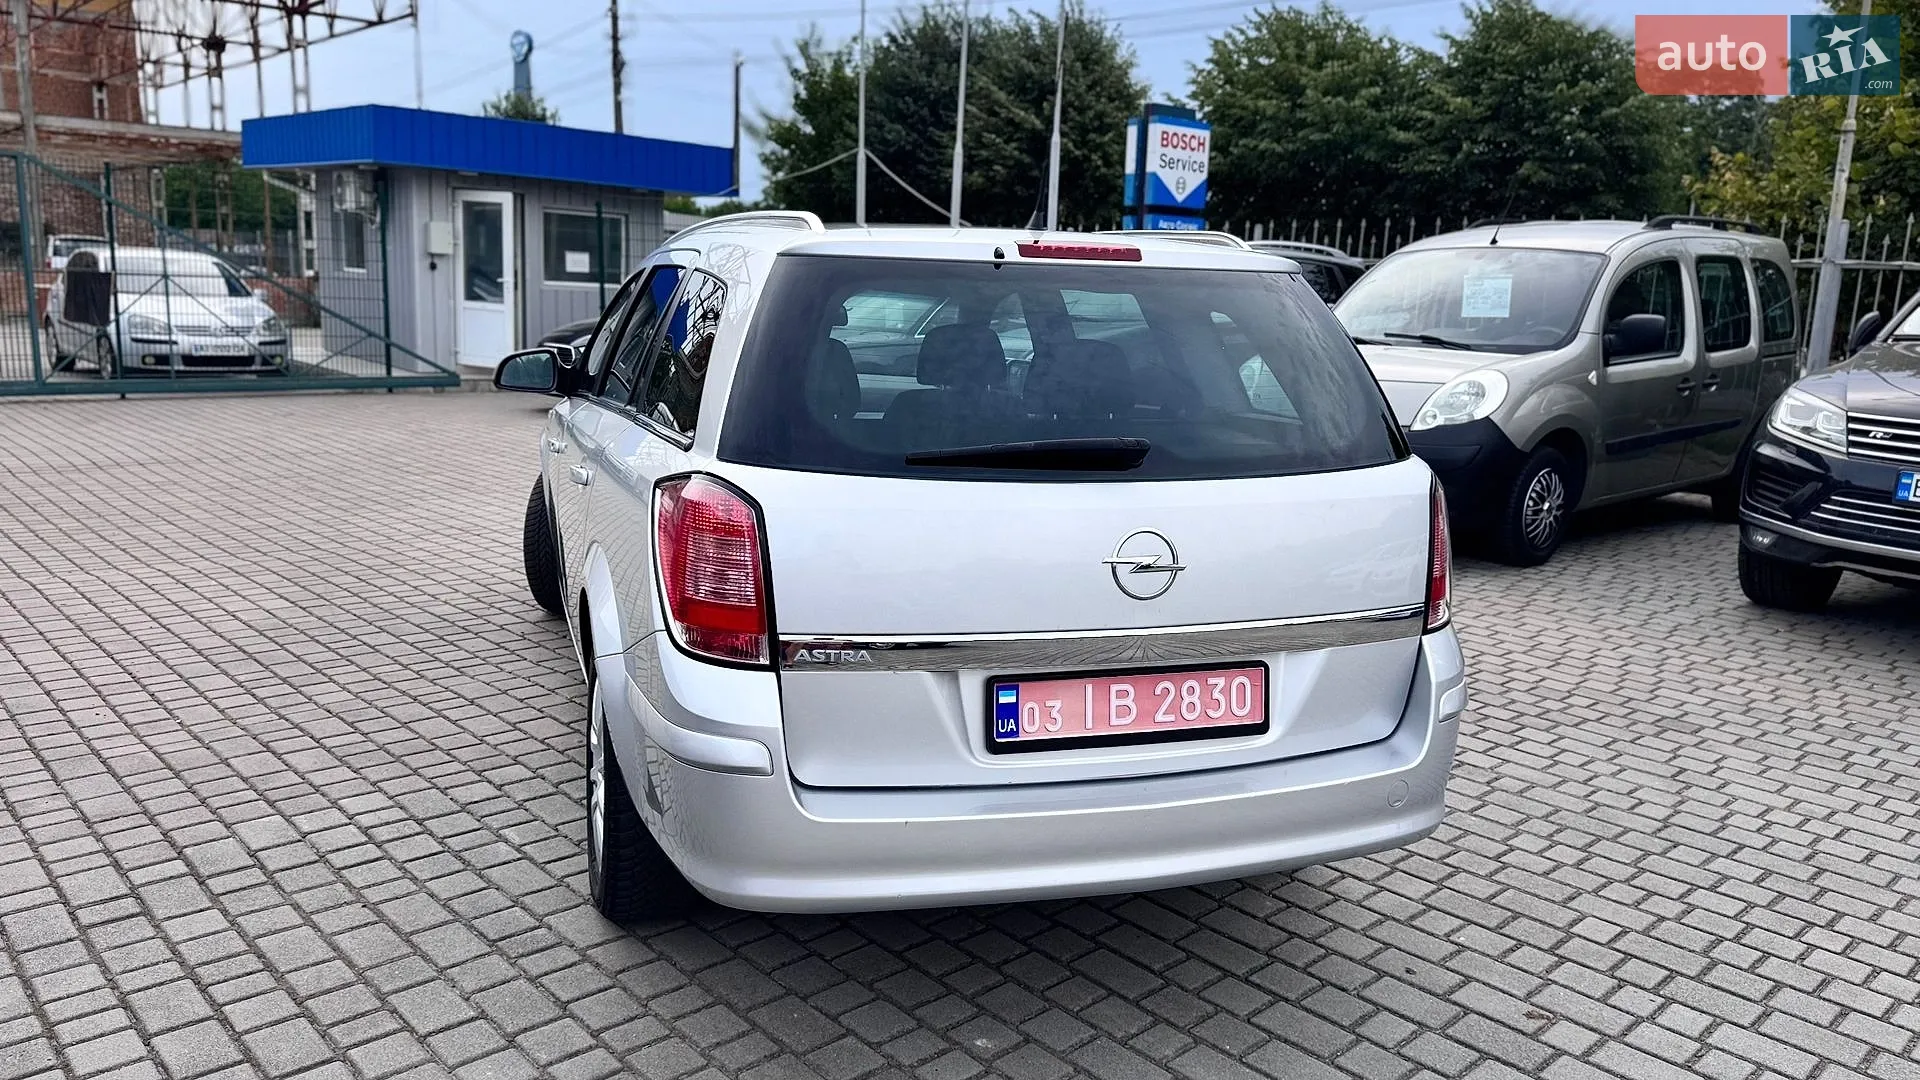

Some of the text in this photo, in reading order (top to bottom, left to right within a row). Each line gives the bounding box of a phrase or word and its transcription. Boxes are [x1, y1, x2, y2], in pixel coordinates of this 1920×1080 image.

[1160, 131, 1206, 152] BOSCH
[1159, 153, 1205, 173] Service
[1898, 489, 1909, 497] UA
[793, 649, 872, 662] ASTRA
[1022, 699, 1063, 733] 03
[1154, 675, 1252, 723] 2830
[998, 719, 1017, 733] UA
